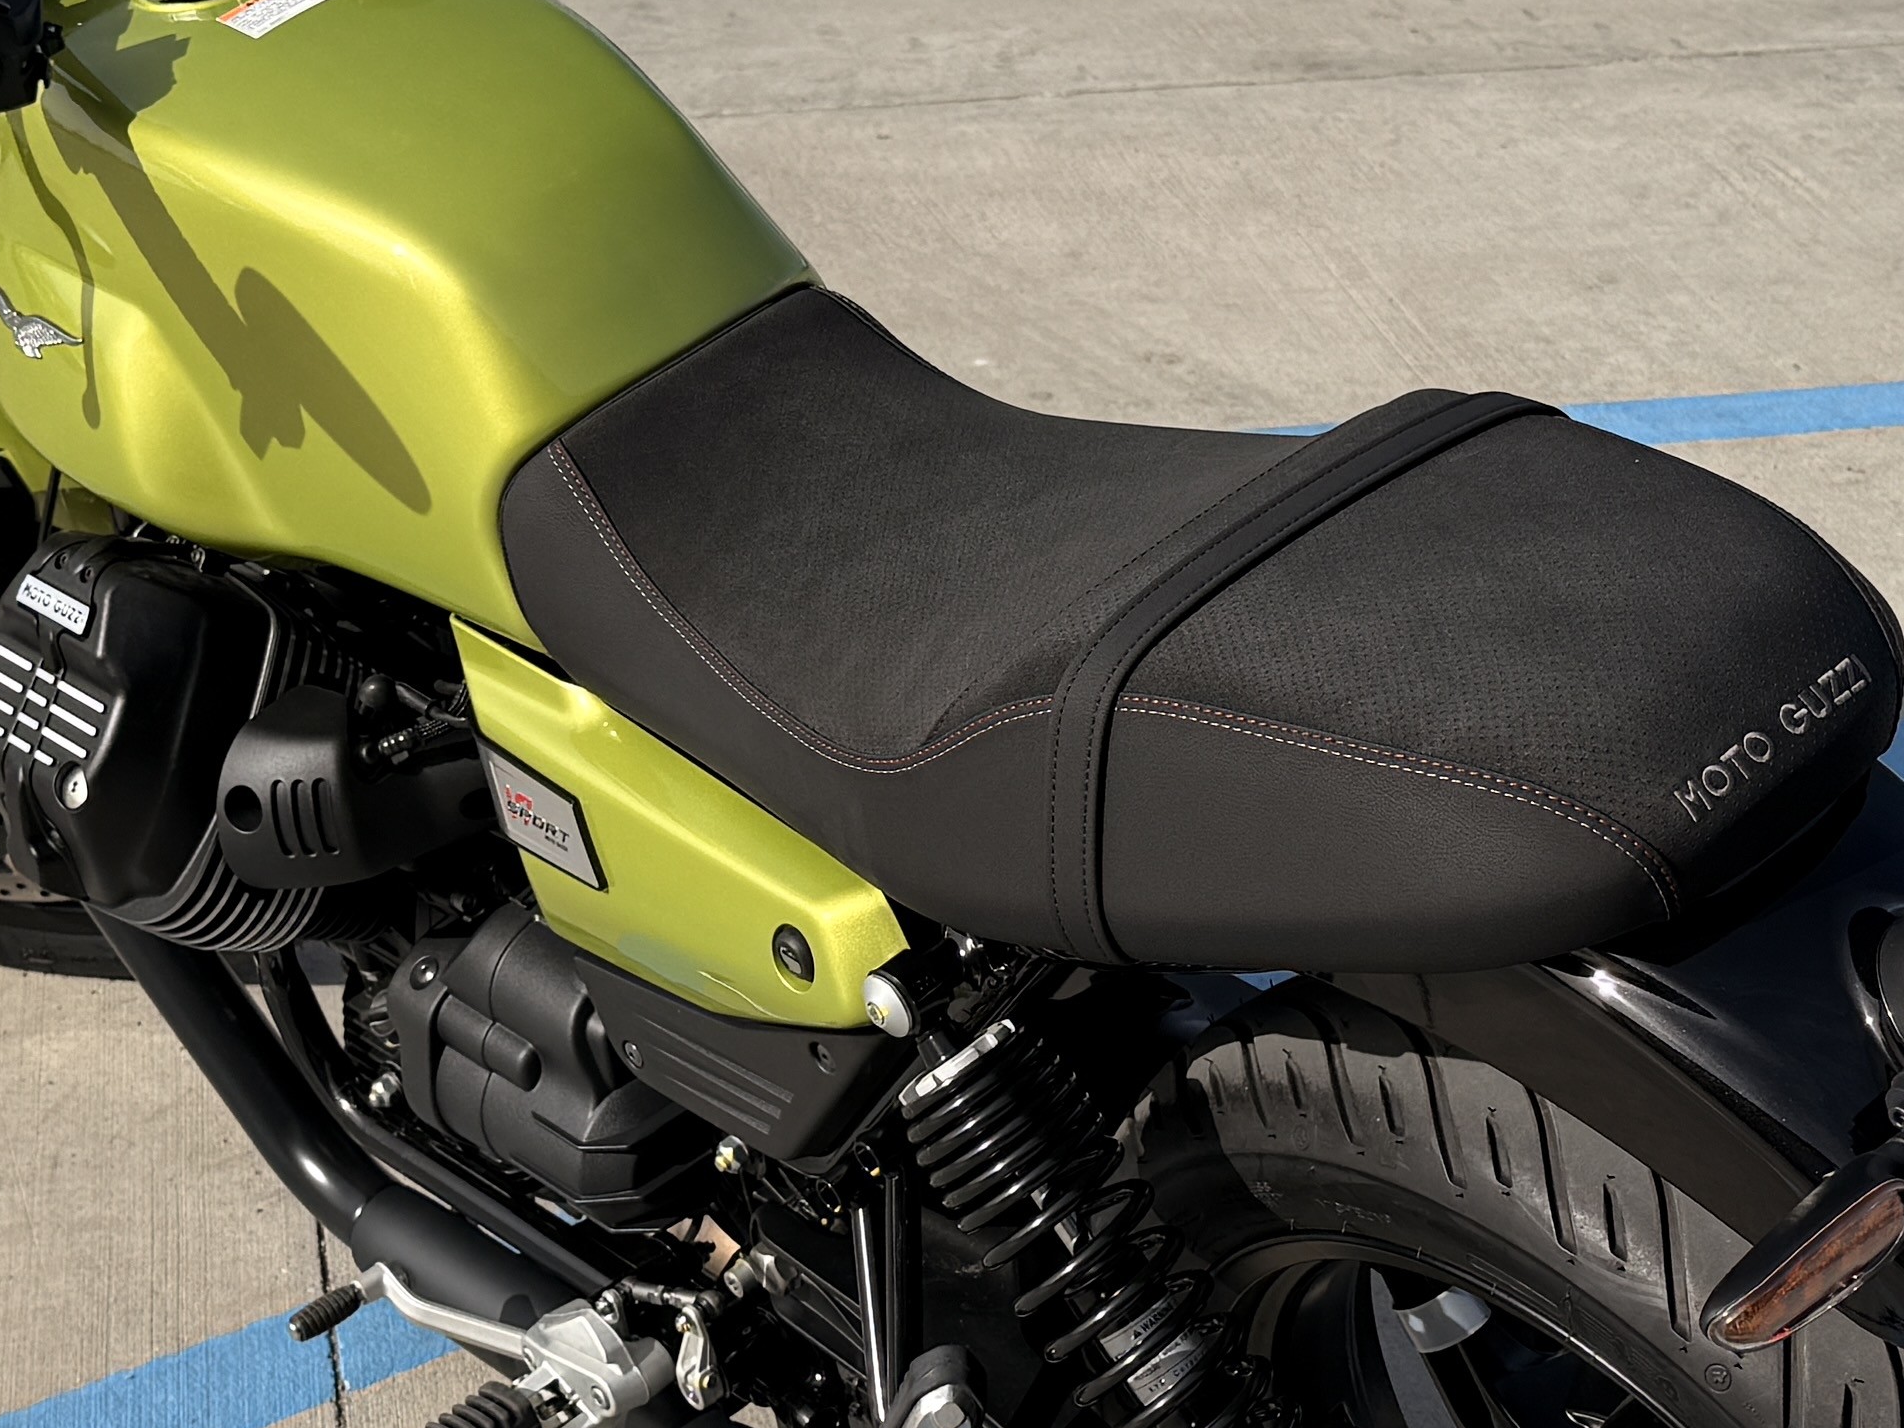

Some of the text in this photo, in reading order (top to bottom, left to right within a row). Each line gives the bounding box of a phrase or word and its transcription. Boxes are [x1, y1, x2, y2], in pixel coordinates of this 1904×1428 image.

[22, 582, 85, 624] MOTO GUZZ
[1673, 653, 1873, 823] MOTO GUZZI
[507, 800, 570, 844] SPORT
